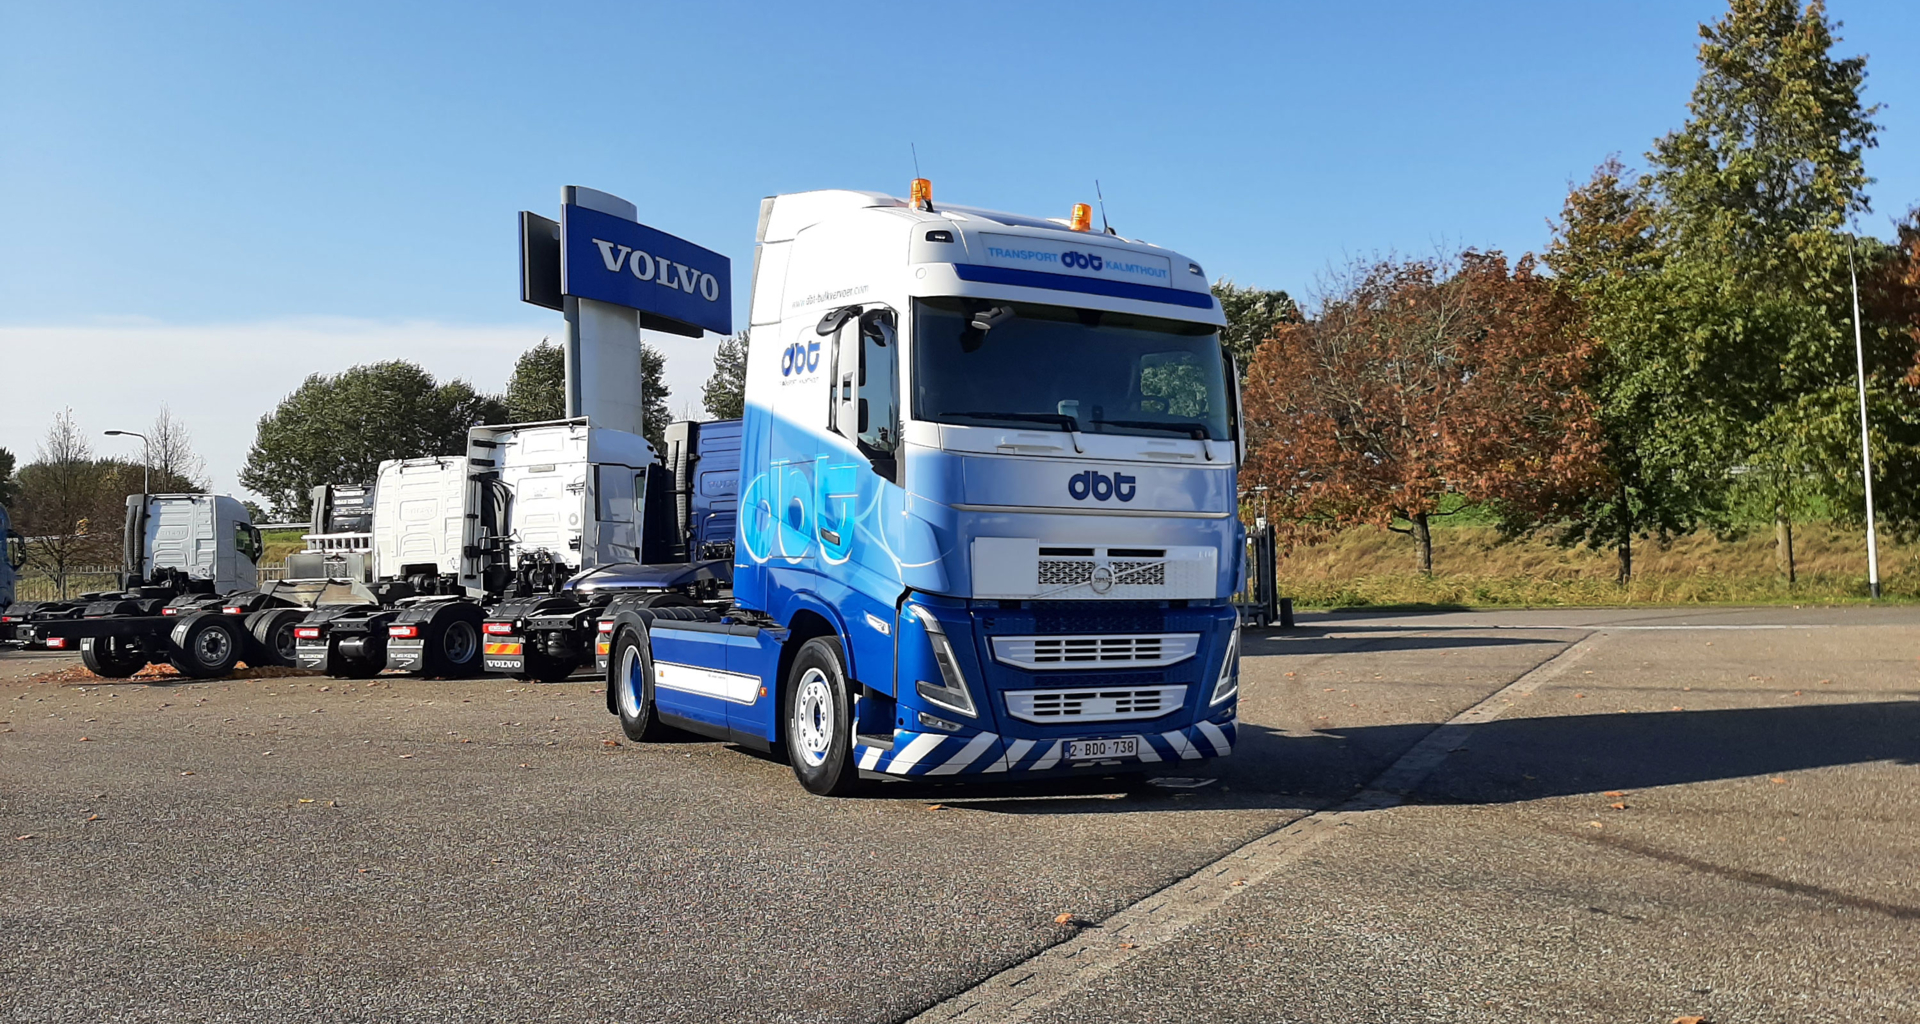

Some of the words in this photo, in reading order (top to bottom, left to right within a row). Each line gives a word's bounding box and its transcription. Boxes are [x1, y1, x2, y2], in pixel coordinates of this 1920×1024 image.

[592, 238, 719, 302] VOLVO
[988, 247, 1058, 263] TRANSPORT
[1061, 251, 1103, 271] dbt
[1105, 260, 1167, 279] KALMTHOUT
[781, 340, 821, 377] dbt
[1068, 470, 1136, 502] dbt
[486, 660, 521, 668] VOLVO
